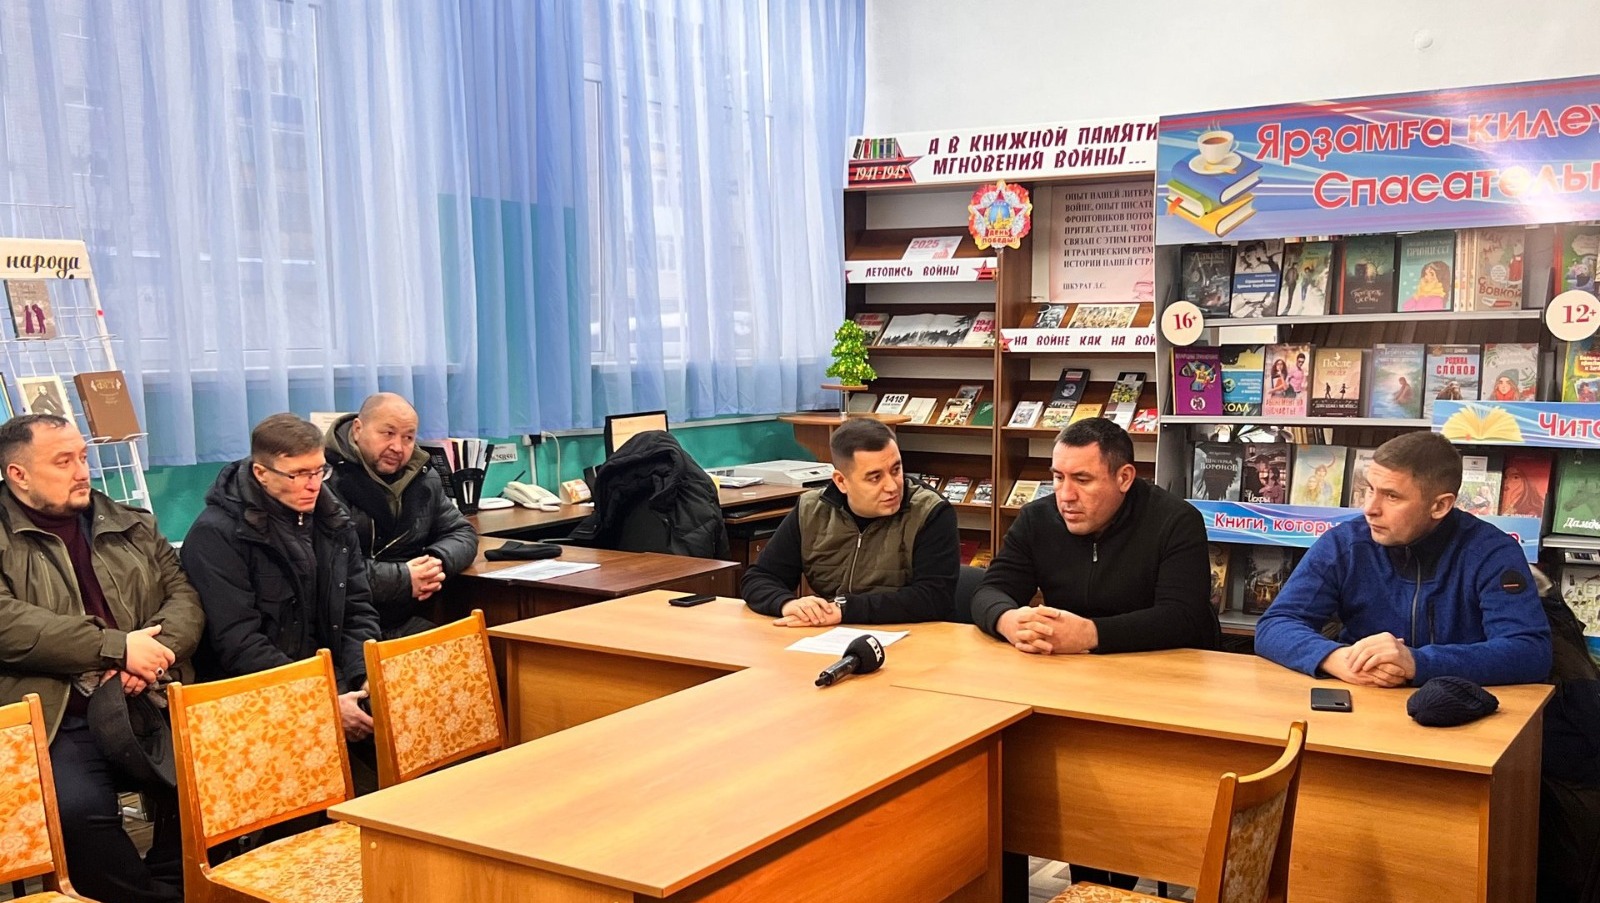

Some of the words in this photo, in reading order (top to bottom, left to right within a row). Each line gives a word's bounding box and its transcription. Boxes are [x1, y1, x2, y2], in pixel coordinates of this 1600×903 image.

[928, 137, 940, 155] А
[948, 135, 960, 153] В
[970, 126, 1068, 152] КНИЖНОЙ
[1078, 122, 1159, 145] ПАМЯТИ
[1256, 118, 1452, 166] Ярҙамға
[933, 150, 1045, 175] МГНОВЕНИЯ
[854, 165, 907, 181] 1941-1945
[1065, 193, 1088, 201] ОПЫТ
[1090, 190, 1120, 200] НАШЕЙ
[1095, 202, 1119, 211] ОПЫТ
[1065, 213, 1125, 223] ФРОНТОВИКОВ
[1130, 224, 1147, 232] ЧТО
[910, 239, 940, 250] 2025
[1064, 237, 1094, 246] СВЯЗАН
[1096, 236, 1102, 245] С
[1103, 236, 1126, 245] ЭТИМ
[1064, 249, 1070, 257] И
[1072, 246, 1131, 257] ТРАГИЧЕСКИМ
[6, 254, 82, 280] народа
[1064, 260, 1101, 268] ИСТОРИИ
[1102, 257, 1133, 267] НАШЕЙ
[865, 266, 913, 278] ЛЕТОПИСЬ
[923, 264, 960, 277] ВОЙНЫ
[1478, 283, 1522, 298] ВОВКОЙ
[1562, 303, 1597, 324] 12+
[1173, 311, 1198, 330] 16+
[1014, 335, 1028, 346] НА
[1036, 333, 1070, 346] ВОЙНЕ
[1079, 334, 1102, 346] КАК
[1111, 335, 1126, 346] НА
[1322, 358, 1352, 368] После
[1445, 356, 1468, 364] РОДИНА
[1436, 364, 1476, 375] СЛОНОВ
[884, 395, 905, 403] 1418
[1214, 512, 1267, 532] Книги,
